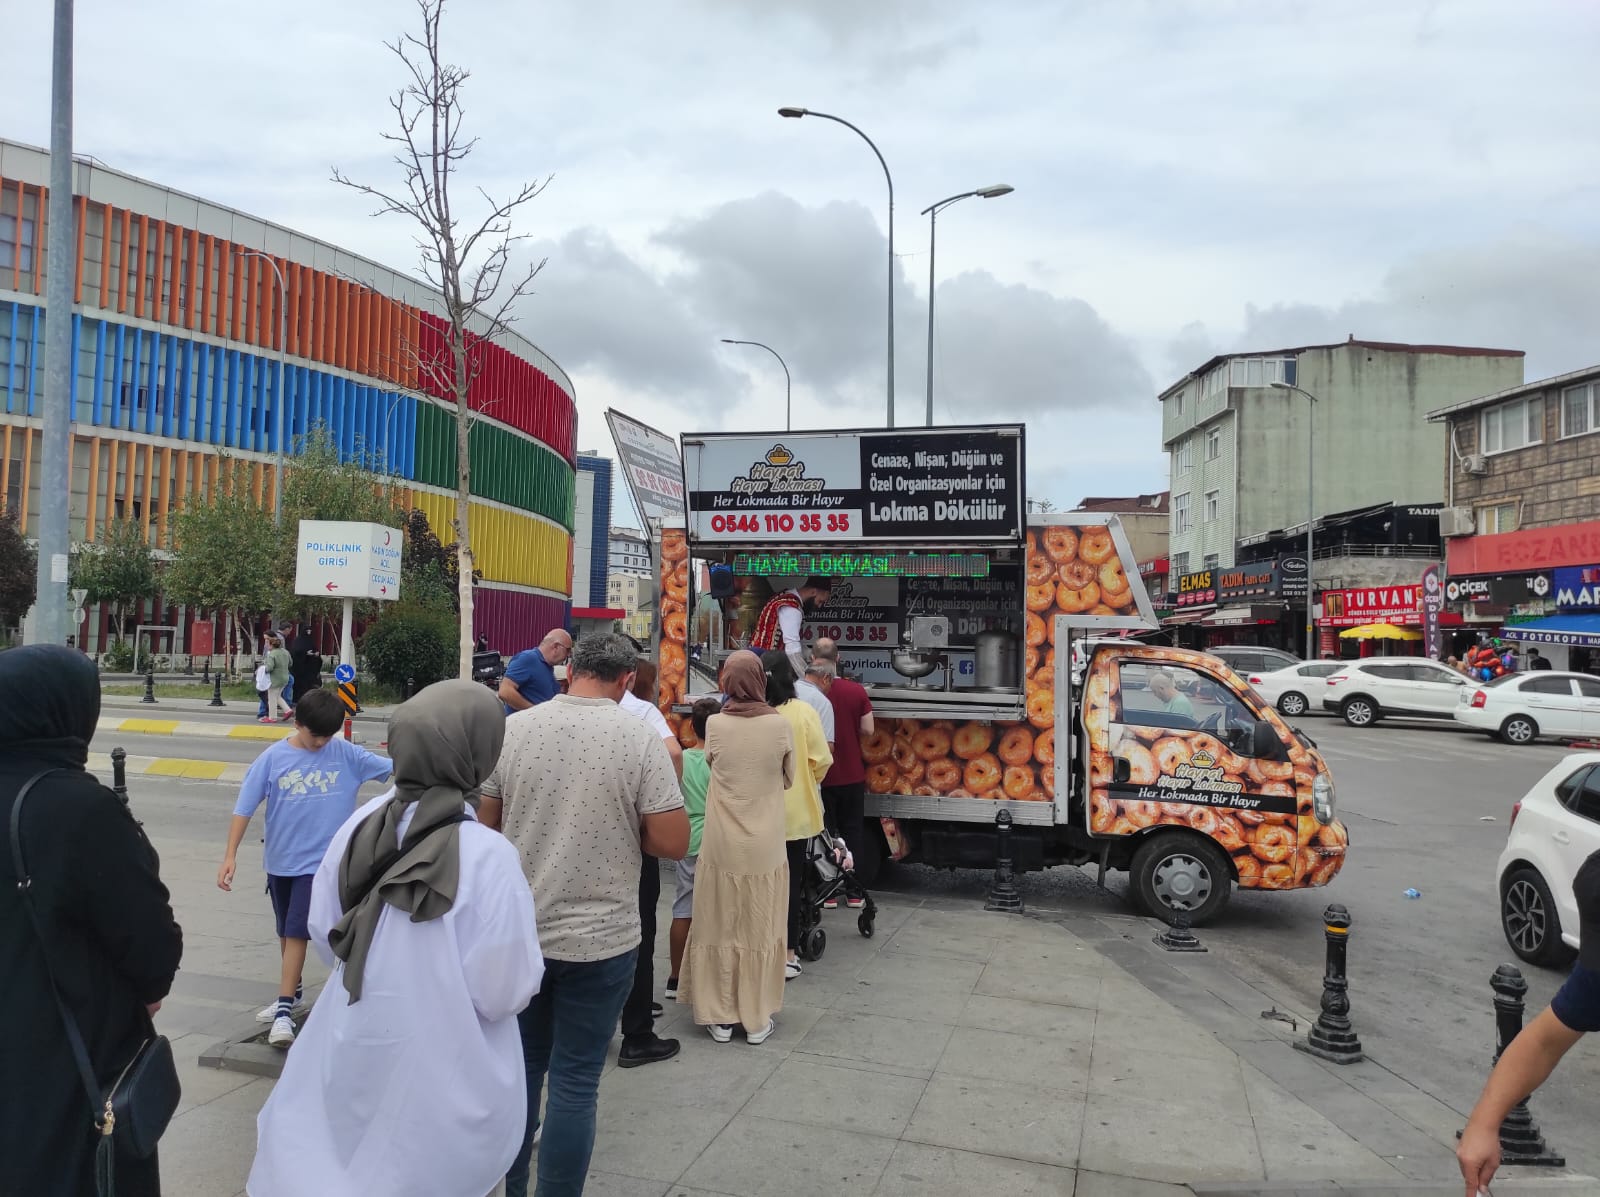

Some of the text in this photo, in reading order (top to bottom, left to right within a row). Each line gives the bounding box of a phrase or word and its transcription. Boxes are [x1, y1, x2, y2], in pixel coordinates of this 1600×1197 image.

[871, 449, 1003, 470] Cenaze, Nişan, Düğün ve
[751, 462, 804, 481] Hayrat
[732, 479, 824, 494] Hayır Lokması
[869, 472, 1006, 495] Özel Organizasyonlar için
[713, 494, 844, 508] Her Lokmada Bir Hayır
[870, 498, 1006, 522] Lokma Dökülür
[711, 513, 850, 533] 0546 110 35 35
[1180, 572, 1211, 592] ELMAS
[1219, 572, 1244, 589] TADIM
[1460, 580, 1488, 595] ÇİÇEK
[1346, 589, 1413, 607] TURVAN
[841, 609, 855, 619] Bir
[857, 609, 885, 621] Hayır
[817, 625, 842, 640] 110
[846, 625, 864, 641] 35
[869, 625, 888, 641] 35
[1587, 637, 1600, 645] MA
[1175, 764, 1225, 780] Hayrat
[1157, 775, 1242, 793] Hayır Lokması
[1138, 787, 1261, 808] Her Lokmada Bir Hayır
